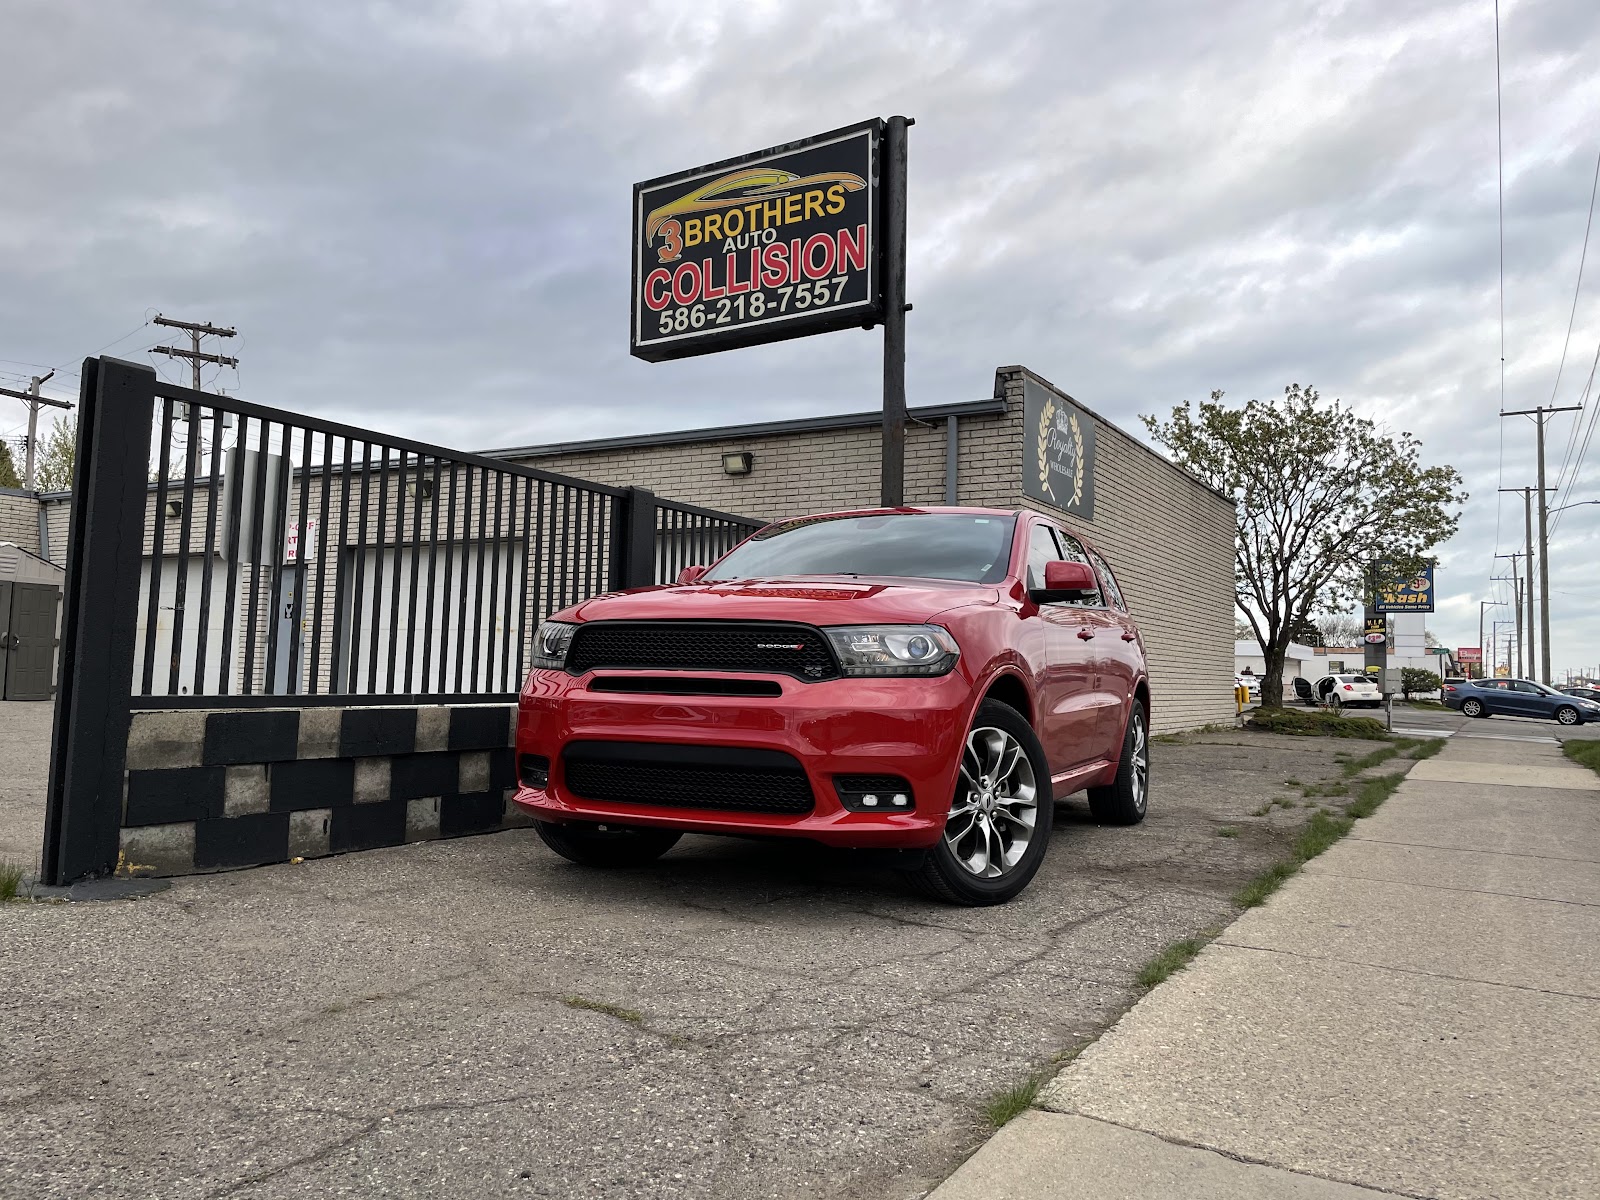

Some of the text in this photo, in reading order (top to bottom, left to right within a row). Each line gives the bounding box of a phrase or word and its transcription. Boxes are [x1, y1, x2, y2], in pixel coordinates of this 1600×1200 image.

[658, 184, 846, 260] 3 BROTHERS
[722, 227, 777, 253] AUTO
[644, 224, 867, 311] COLLISION
[658, 275, 849, 334] 586-218-7557
[1047, 427, 1077, 468] Royalty
[1050, 460, 1073, 479] WHOLESALE
